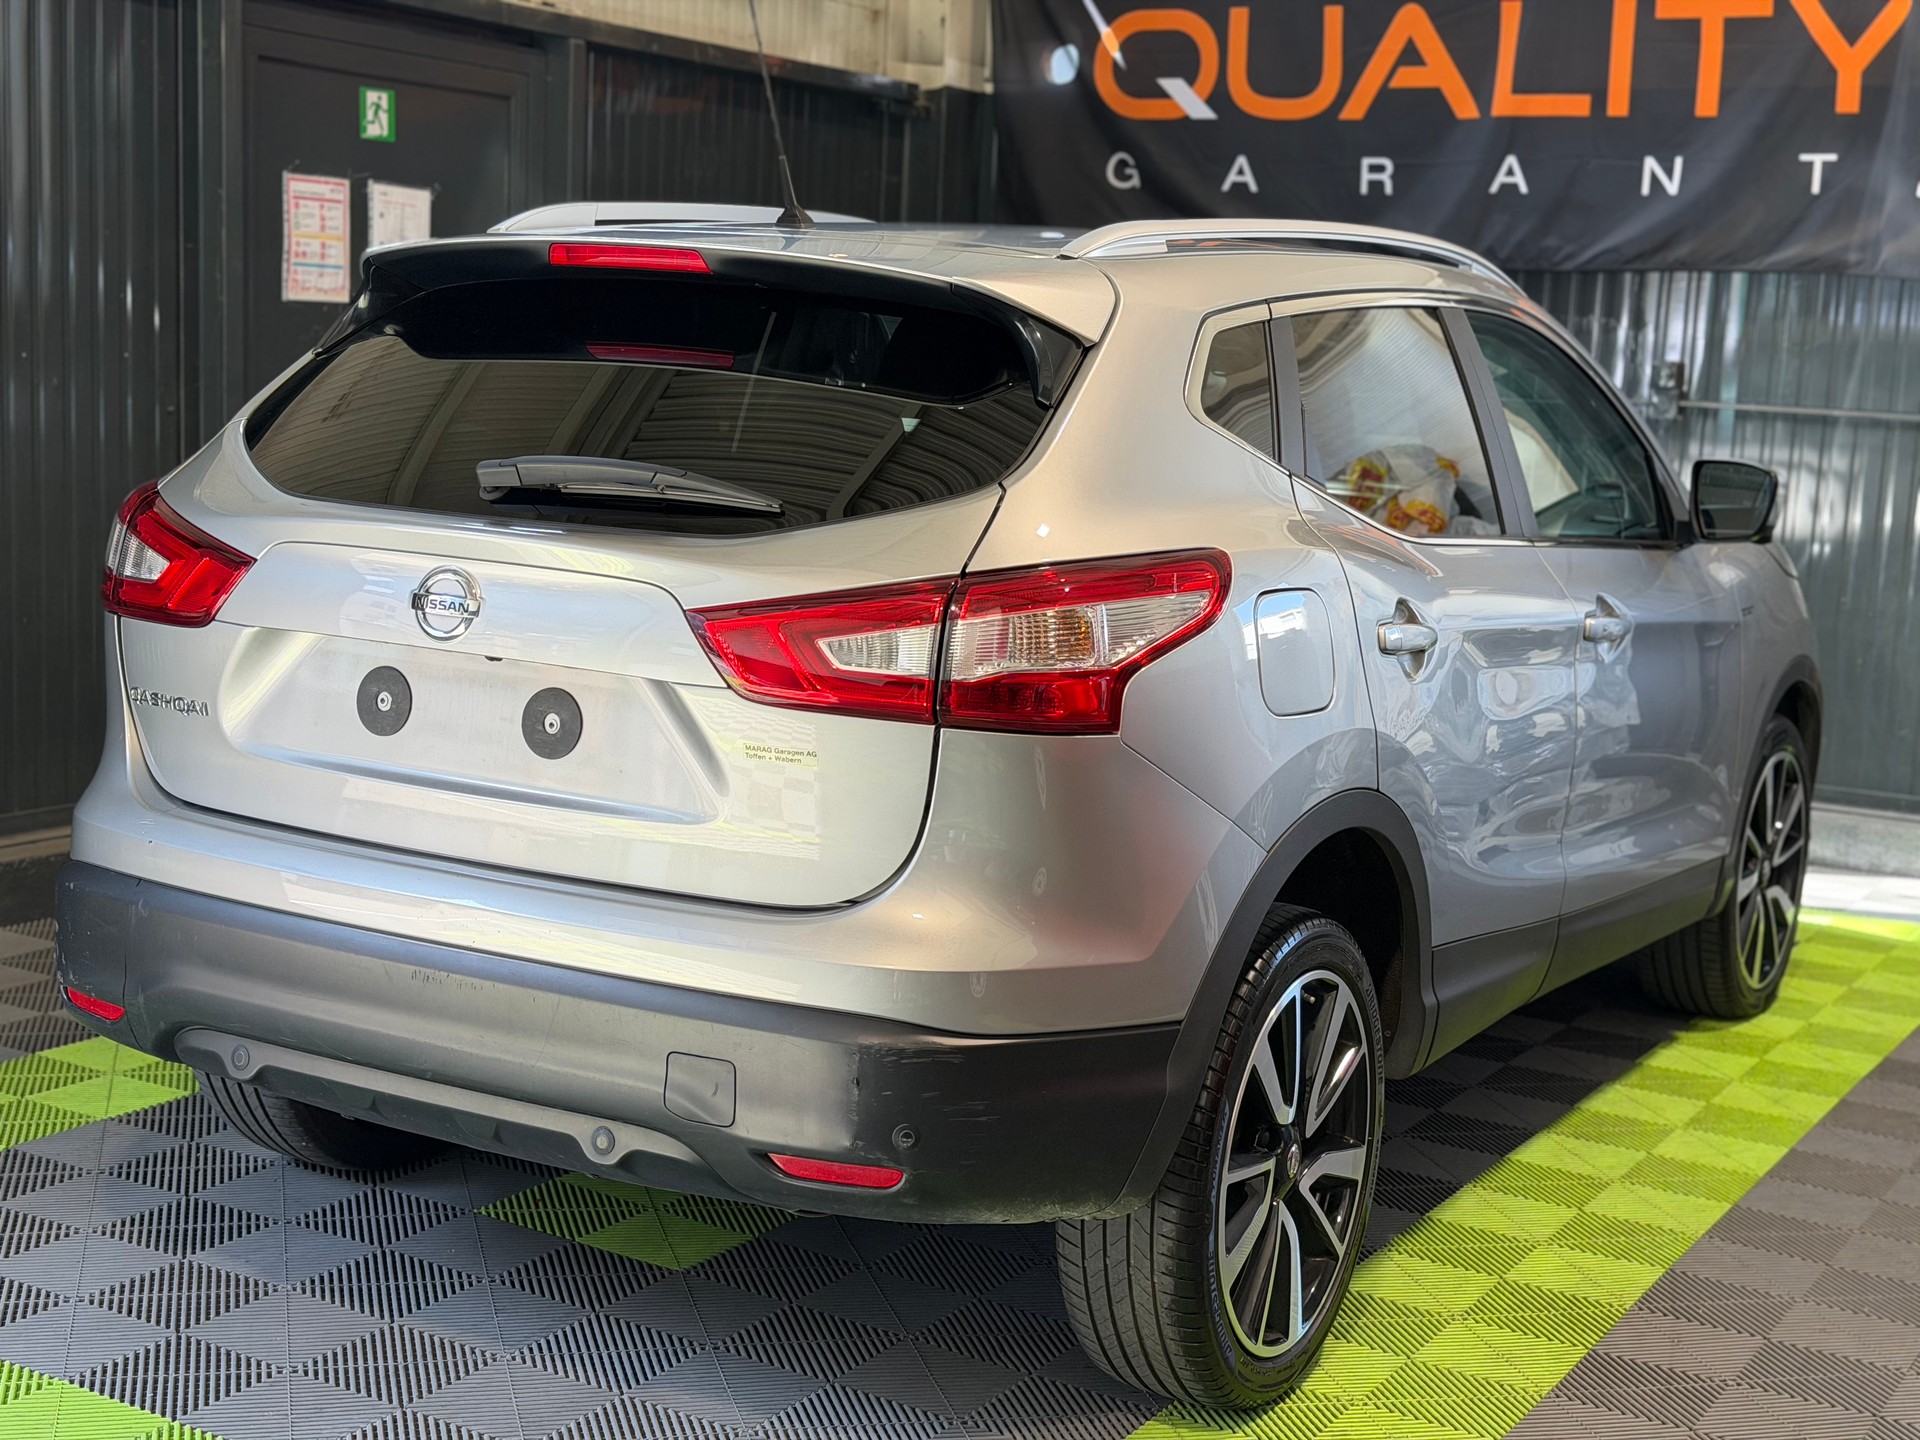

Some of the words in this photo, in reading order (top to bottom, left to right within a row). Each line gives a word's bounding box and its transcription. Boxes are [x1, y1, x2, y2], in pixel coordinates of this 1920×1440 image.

[1093, 0, 1913, 121] QUALITY
[1105, 151, 1920, 198] GARANT
[413, 594, 470, 613] NISSAN
[130, 686, 210, 716] QASHQAI
[745, 745, 772, 753] MARAG
[774, 748, 804, 757] Garagen
[745, 752, 766, 760] Toffen
[775, 755, 802, 763] Wabern
